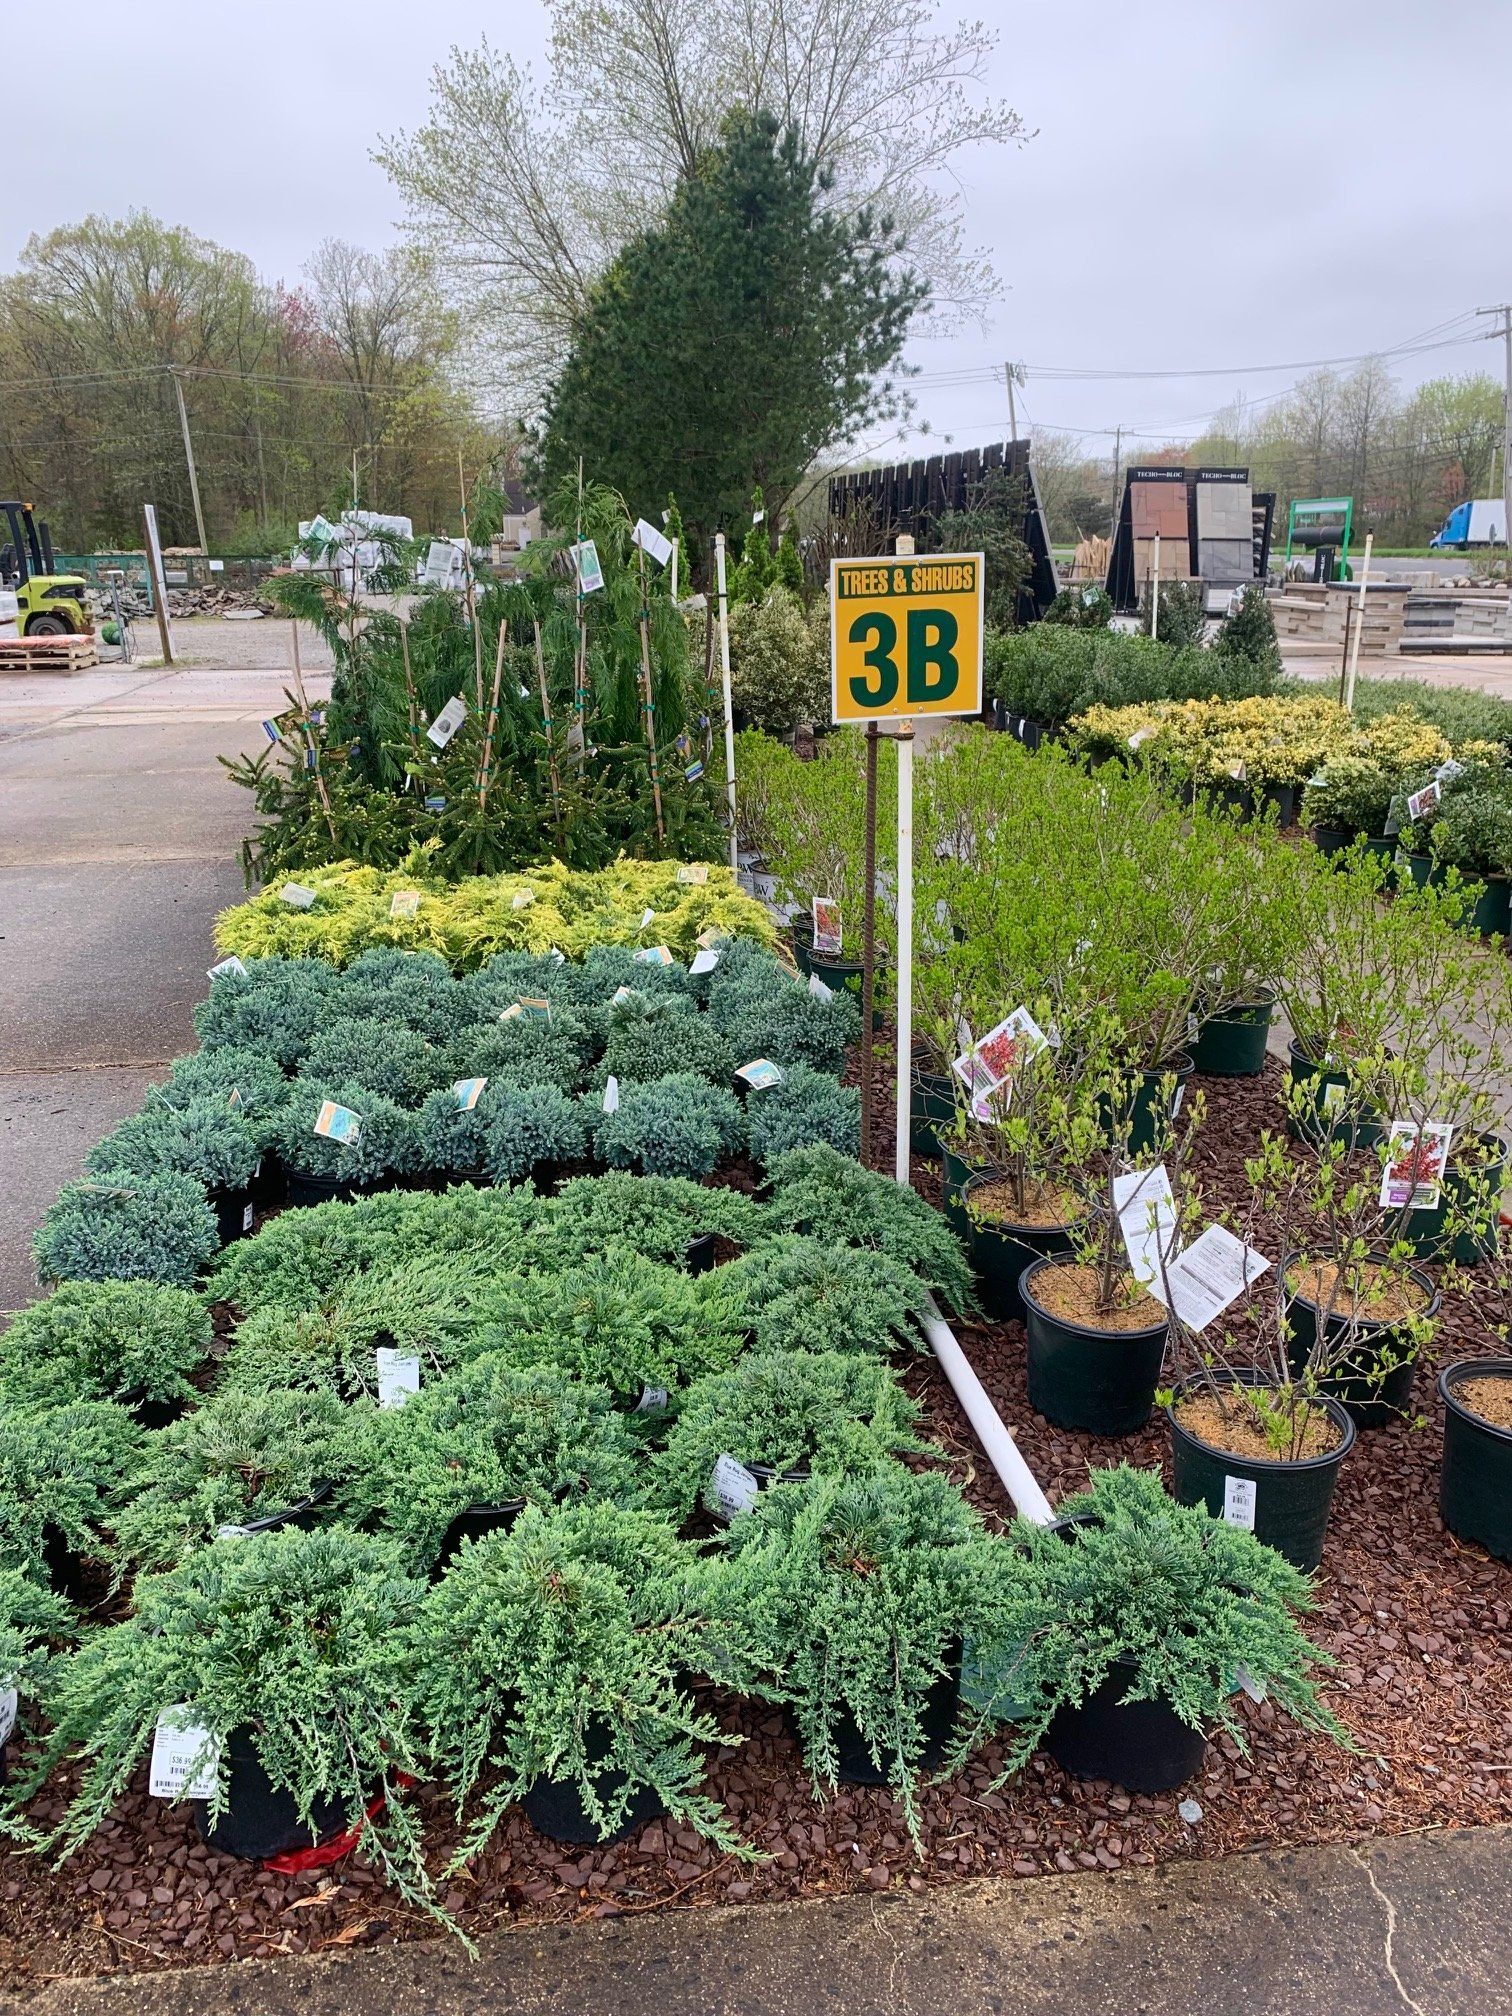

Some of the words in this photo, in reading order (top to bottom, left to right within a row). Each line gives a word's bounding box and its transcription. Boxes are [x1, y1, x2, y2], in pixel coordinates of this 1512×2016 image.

[841, 569, 889, 596] TREES
[893, 568, 907, 593] &
[911, 565, 973, 592] SHRUBS
[848, 608, 959, 708] 3B
